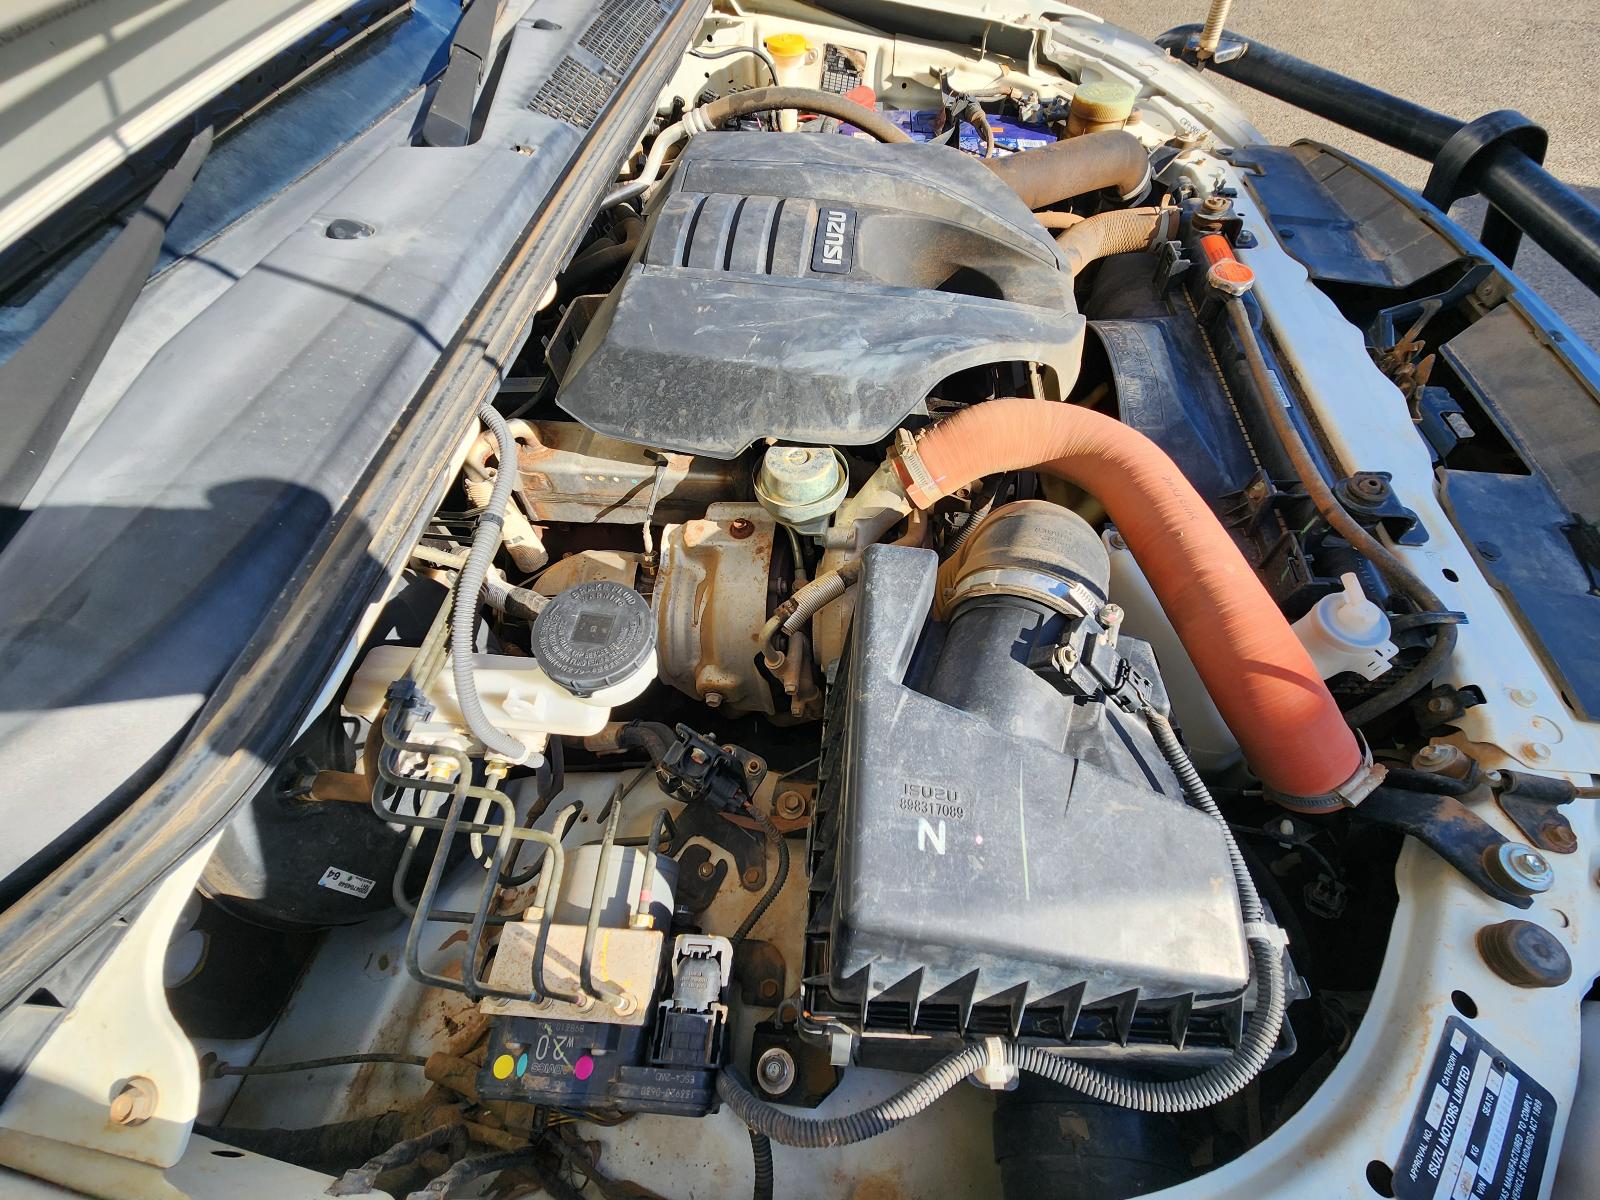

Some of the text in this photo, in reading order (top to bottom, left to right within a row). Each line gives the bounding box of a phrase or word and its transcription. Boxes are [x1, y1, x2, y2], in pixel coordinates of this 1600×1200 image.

[822, 211, 846, 265] ISUZU
[612, 585, 636, 605] FLUID
[900, 798, 964, 819] 898317089
[904, 783, 957, 802] ISUZU
[918, 817, 946, 855] N
[327, 870, 341, 881] 64
[1409, 1051, 1458, 1182] APPROVAL NO. CATEGORY
[1428, 1144, 1445, 1178] ISUZU
[1438, 1102, 1459, 1147] MOTORS
[1452, 1065, 1471, 1104] LIMITED
[1521, 1093, 1533, 1121] COMPLY
[1470, 1093, 1494, 1158] KG SEATS
[1518, 1121, 1527, 1132] TO
[1503, 1133, 1523, 1190] MANUFACTURED
[1519, 1131, 1535, 1174] STANDARDS
[1529, 1116, 1538, 1134] ACT
[1476, 1179, 1487, 1196] VIN
